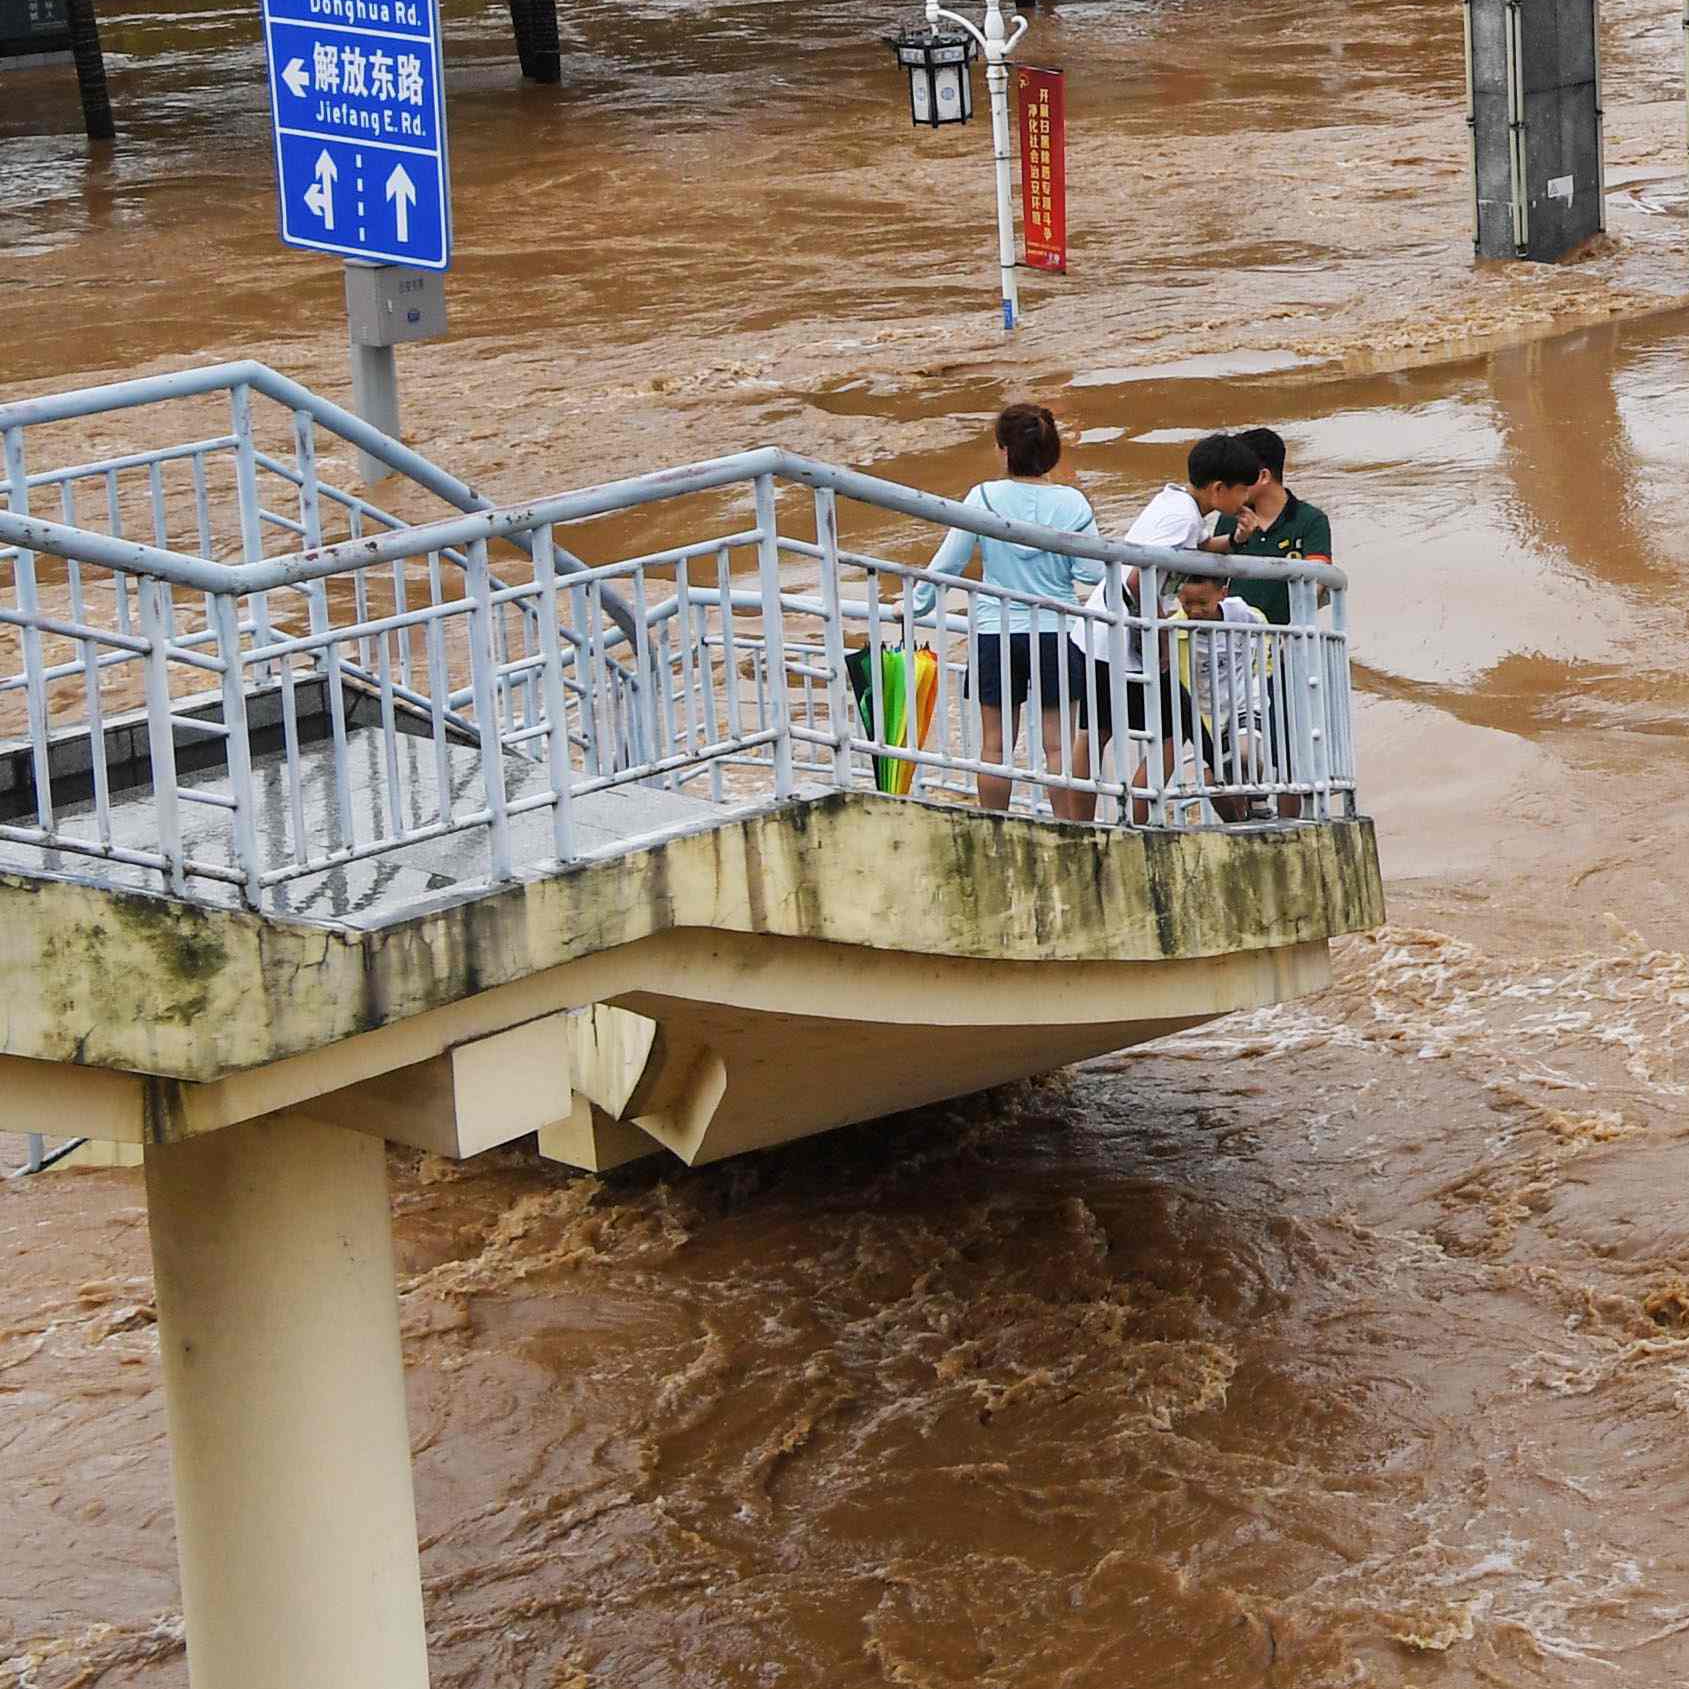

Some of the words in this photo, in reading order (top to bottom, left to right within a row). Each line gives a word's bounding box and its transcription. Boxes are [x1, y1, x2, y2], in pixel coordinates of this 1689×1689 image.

[395, 1, 422, 26] Rd.
[313, 41, 424, 106] 解放东路
[316, 100, 380, 136] Jiefang
[383, 110, 398, 132] E.
[401, 112, 426, 136] Rd.
